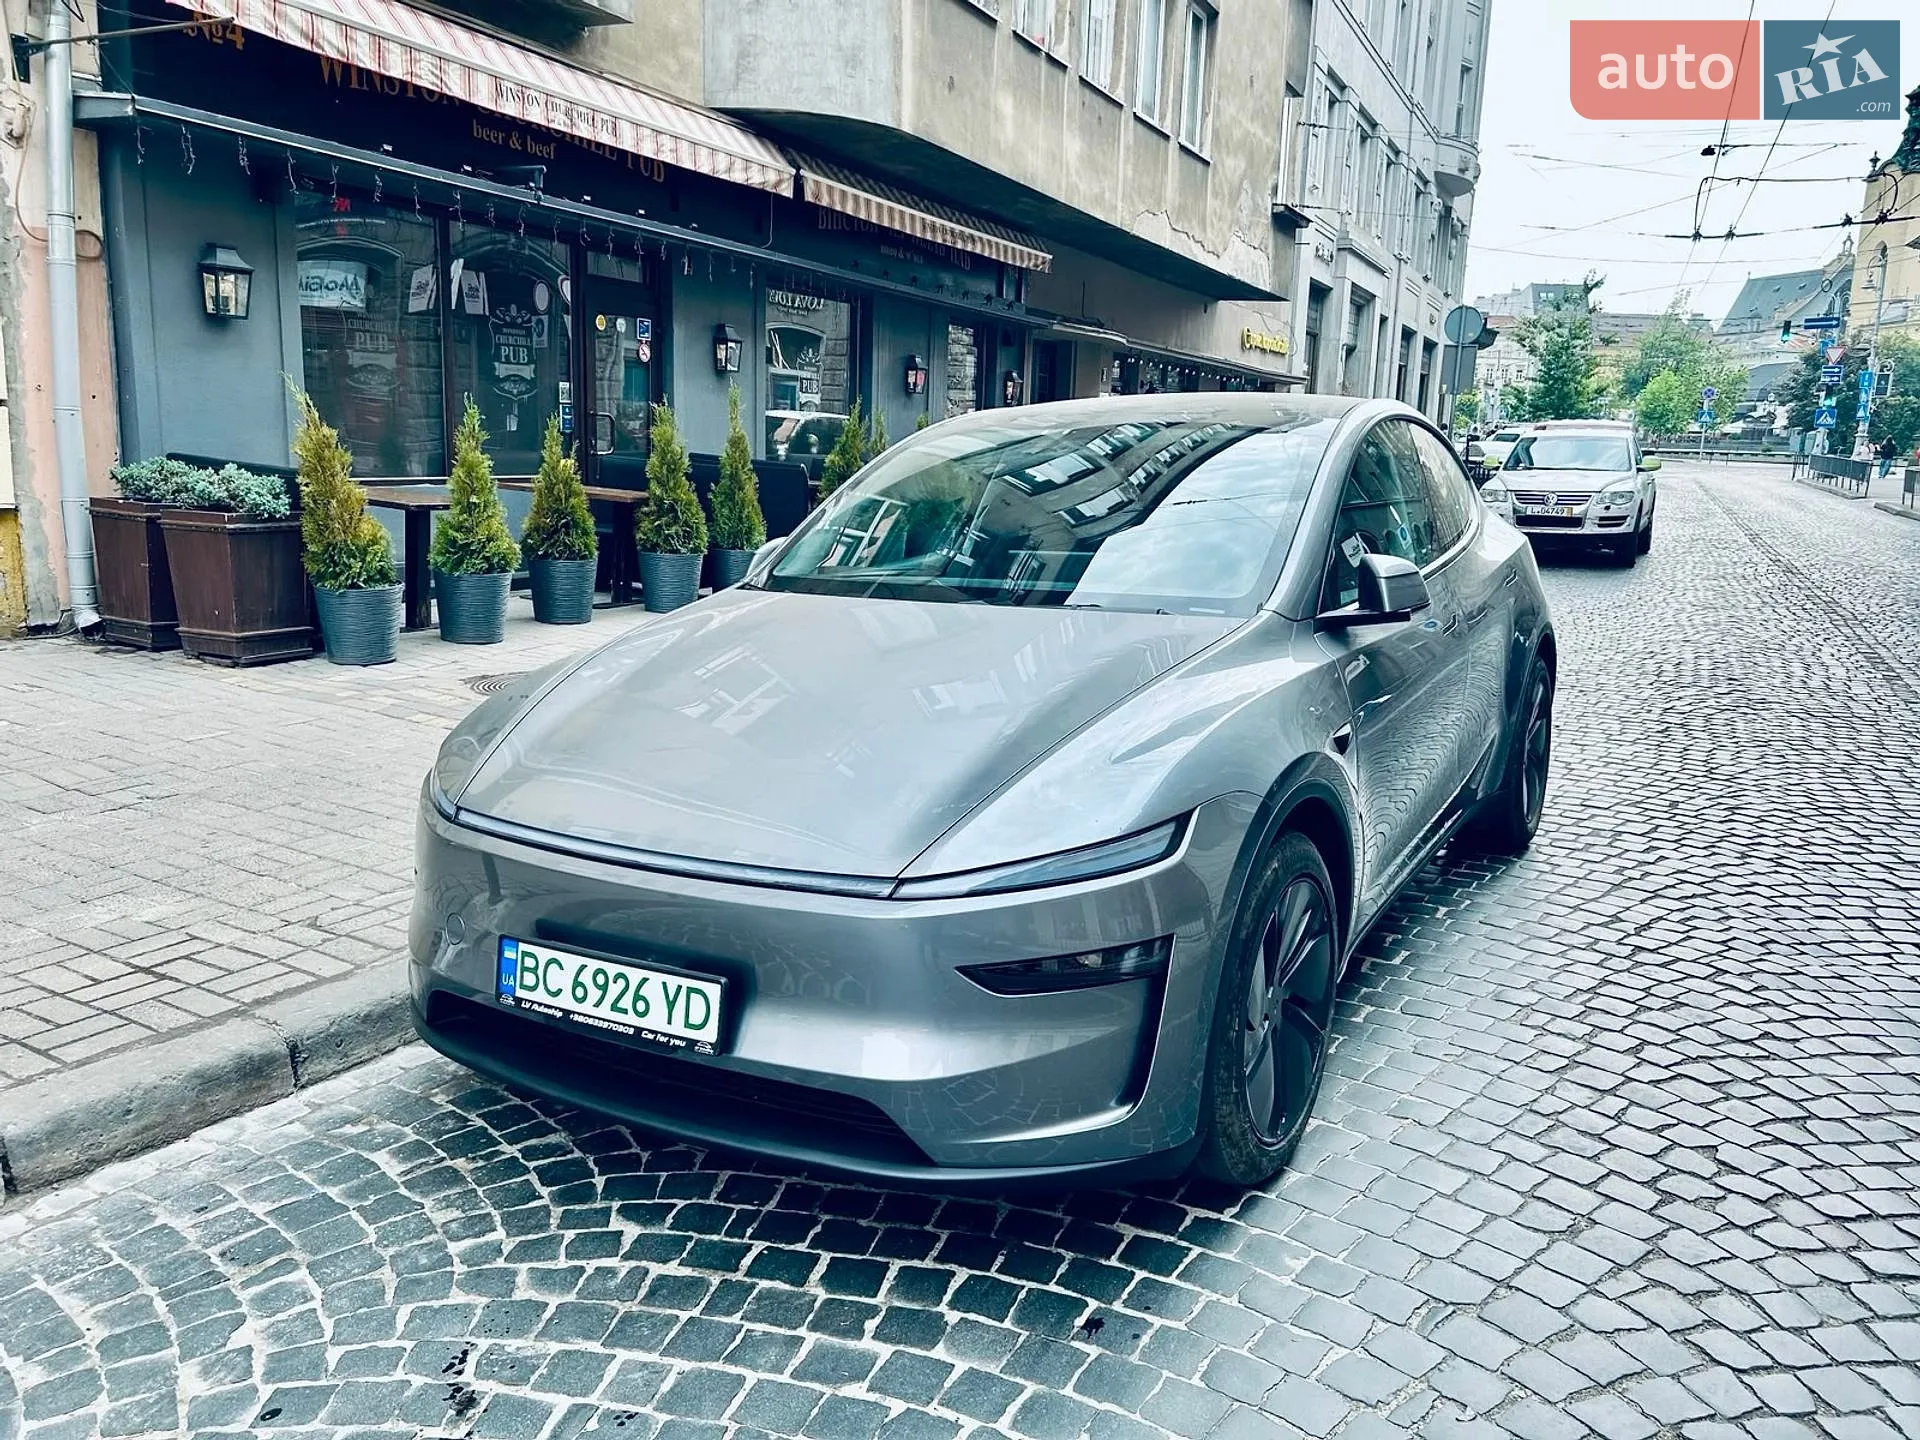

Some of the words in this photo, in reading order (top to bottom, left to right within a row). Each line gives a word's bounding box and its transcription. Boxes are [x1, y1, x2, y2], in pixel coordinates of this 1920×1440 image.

[473, 119, 505, 145] beer
[509, 131, 522, 151] &
[527, 135, 557, 160] beef
[500, 346, 528, 363] PUB
[802, 380, 819, 393] PUB
[502, 974, 515, 988] UA
[519, 951, 565, 998] BC
[571, 964, 651, 1018] 6926
[661, 981, 711, 1031] YD
[521, 1000, 532, 1009] LV
[641, 1030, 656, 1040] Car
[656, 1033, 670, 1043] for
[669, 1037, 687, 1047] you
